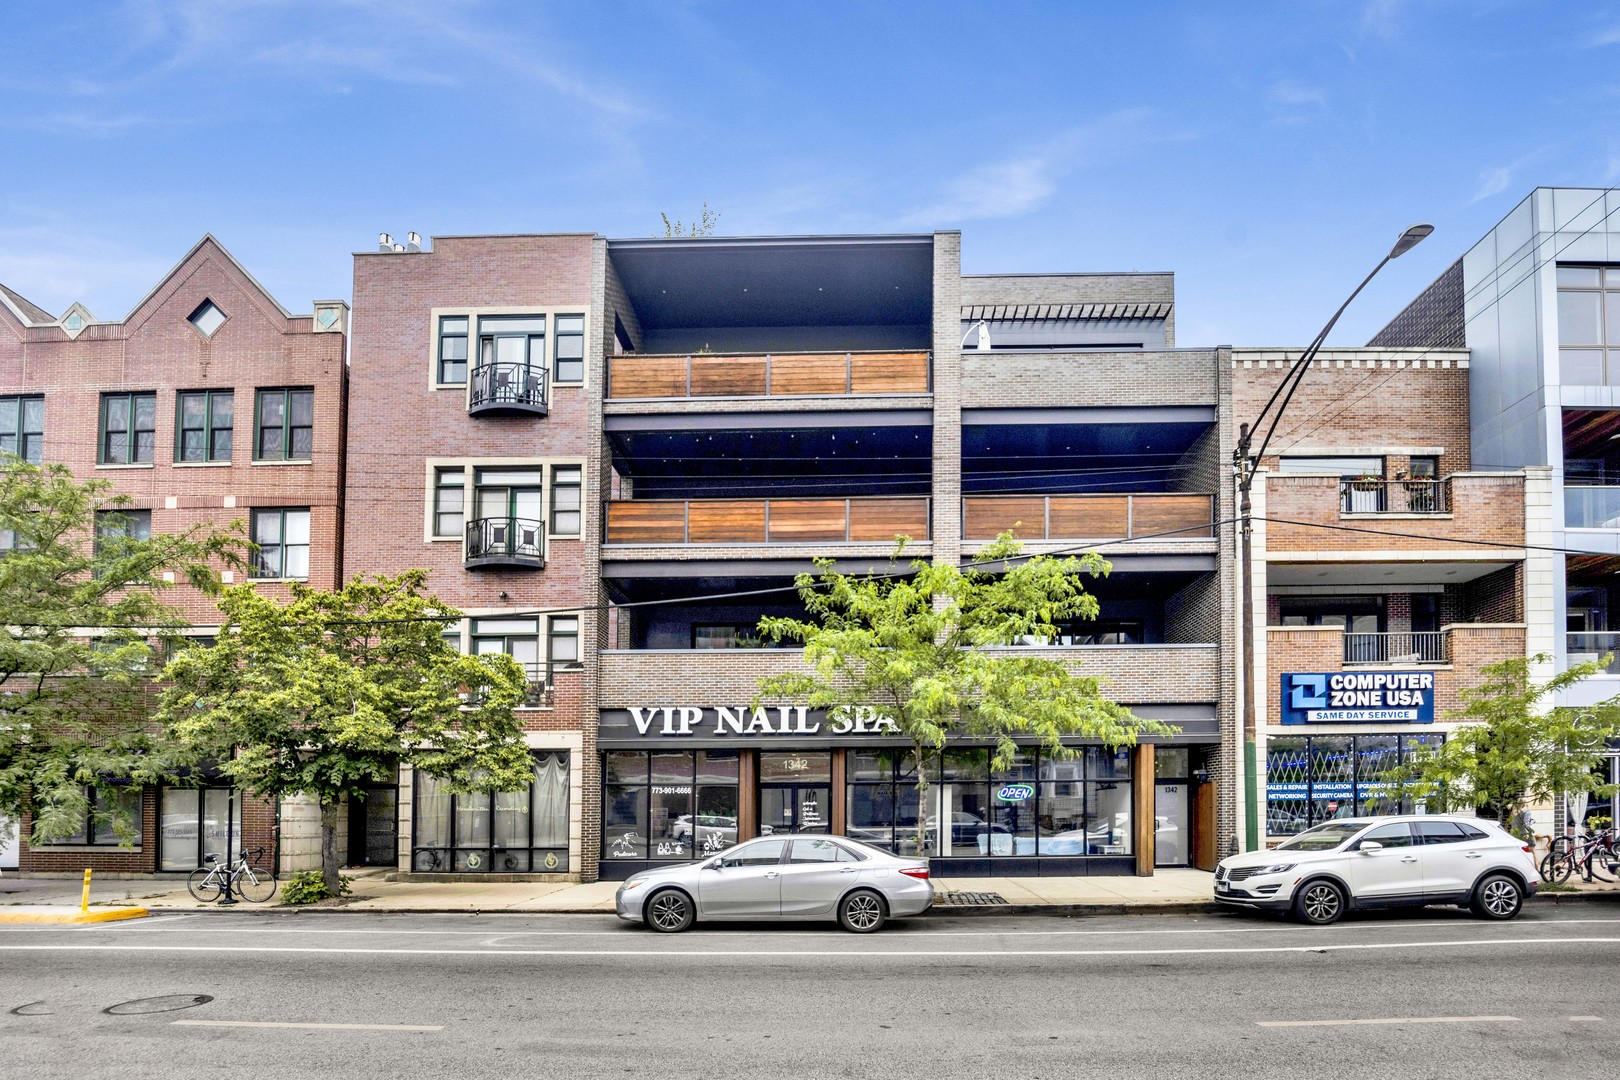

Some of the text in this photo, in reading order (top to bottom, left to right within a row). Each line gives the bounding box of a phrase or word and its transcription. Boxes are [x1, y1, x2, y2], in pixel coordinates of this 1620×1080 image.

[1330, 674, 1433, 689] COMPUTER
[1331, 690, 1424, 706] ZONE USA
[627, 705, 902, 735] VIP NAIL SPA
[1316, 711, 1410, 720] SAME DAY SERVICE
[783, 760, 810, 770] 1342
[1000, 787, 1030, 799] OPEN
